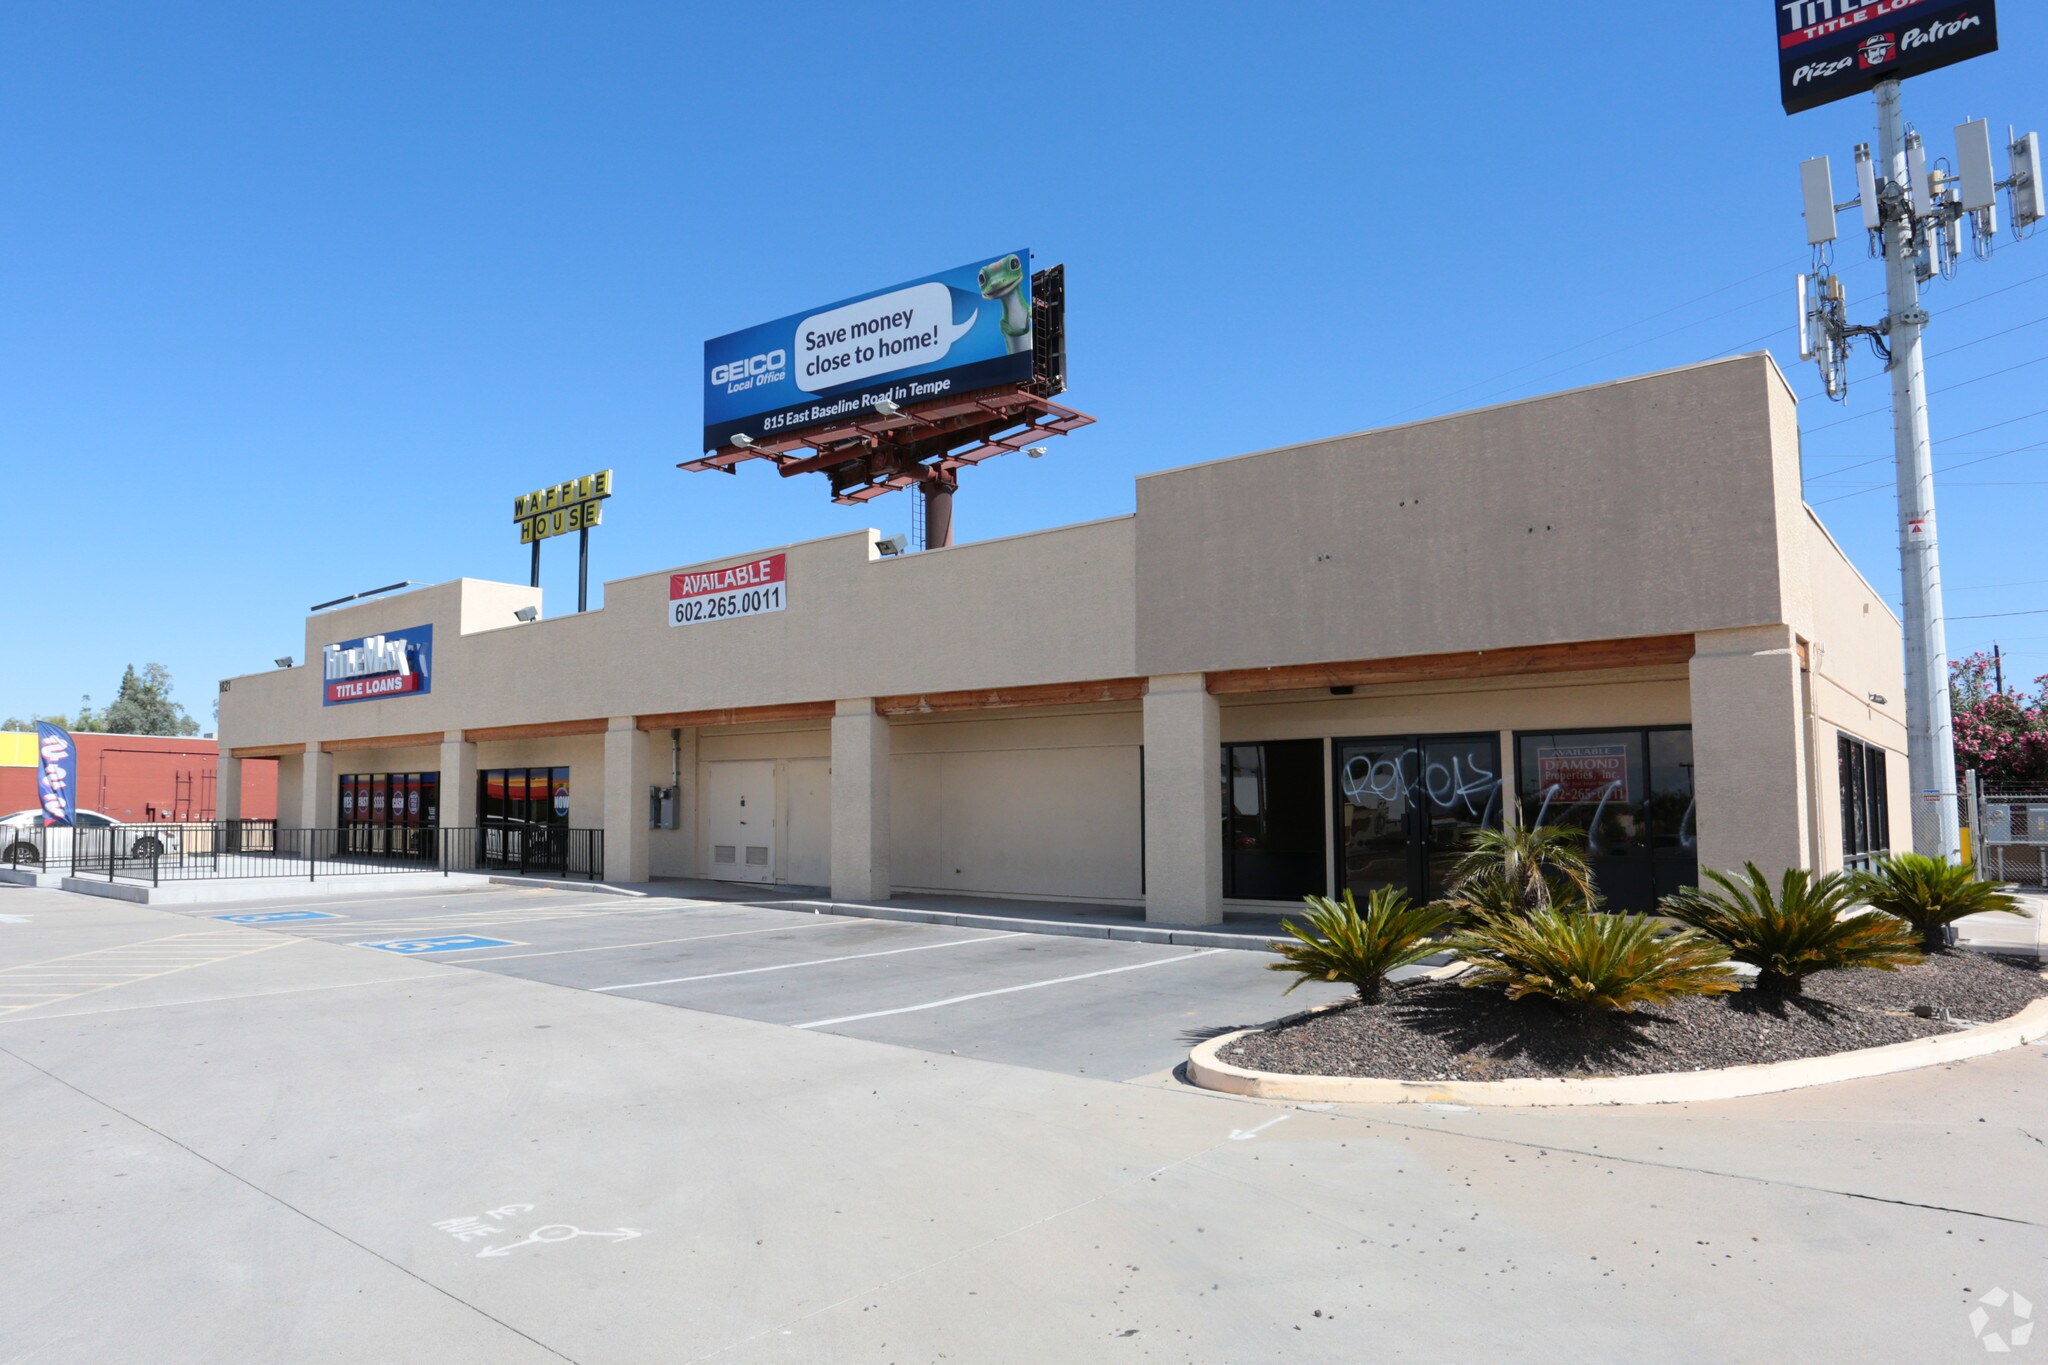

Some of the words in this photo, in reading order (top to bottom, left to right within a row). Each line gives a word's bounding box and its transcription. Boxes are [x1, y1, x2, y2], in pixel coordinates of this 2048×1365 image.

[1803, 10, 1868, 39] TITLE
[1792, 56, 1853, 86] Pizza
[1901, 12, 1981, 50] Patrón
[805, 328, 847, 352] Save
[851, 309, 914, 339] money
[711, 348, 786, 386] GEICO
[806, 353, 851, 377] close
[855, 346, 874, 364] to
[879, 325, 939, 358] home!
[727, 377, 754, 394] Local
[756, 370, 786, 386] Office
[763, 414, 784, 431] 815
[786, 408, 810, 425] East
[811, 398, 860, 420] Baseline
[861, 387, 893, 408] Road
[895, 385, 907, 400] in
[909, 379, 951, 397] Tempe
[514, 473, 606, 517] WAFFLE
[521, 503, 597, 541] HOUSE
[682, 560, 772, 595] AVAILABLE
[675, 586, 780, 623] 602.265.0011
[336, 683, 363, 697] TITLE
[366, 677, 402, 693] LOANS
[1545, 759, 1619, 770] DIAMOND
[1552, 748, 1611, 756] AVAILABLE
[1545, 770, 1597, 782] Properties,
[1602, 769, 1620, 779] Inc.
[554, 795, 570, 809] NOW
